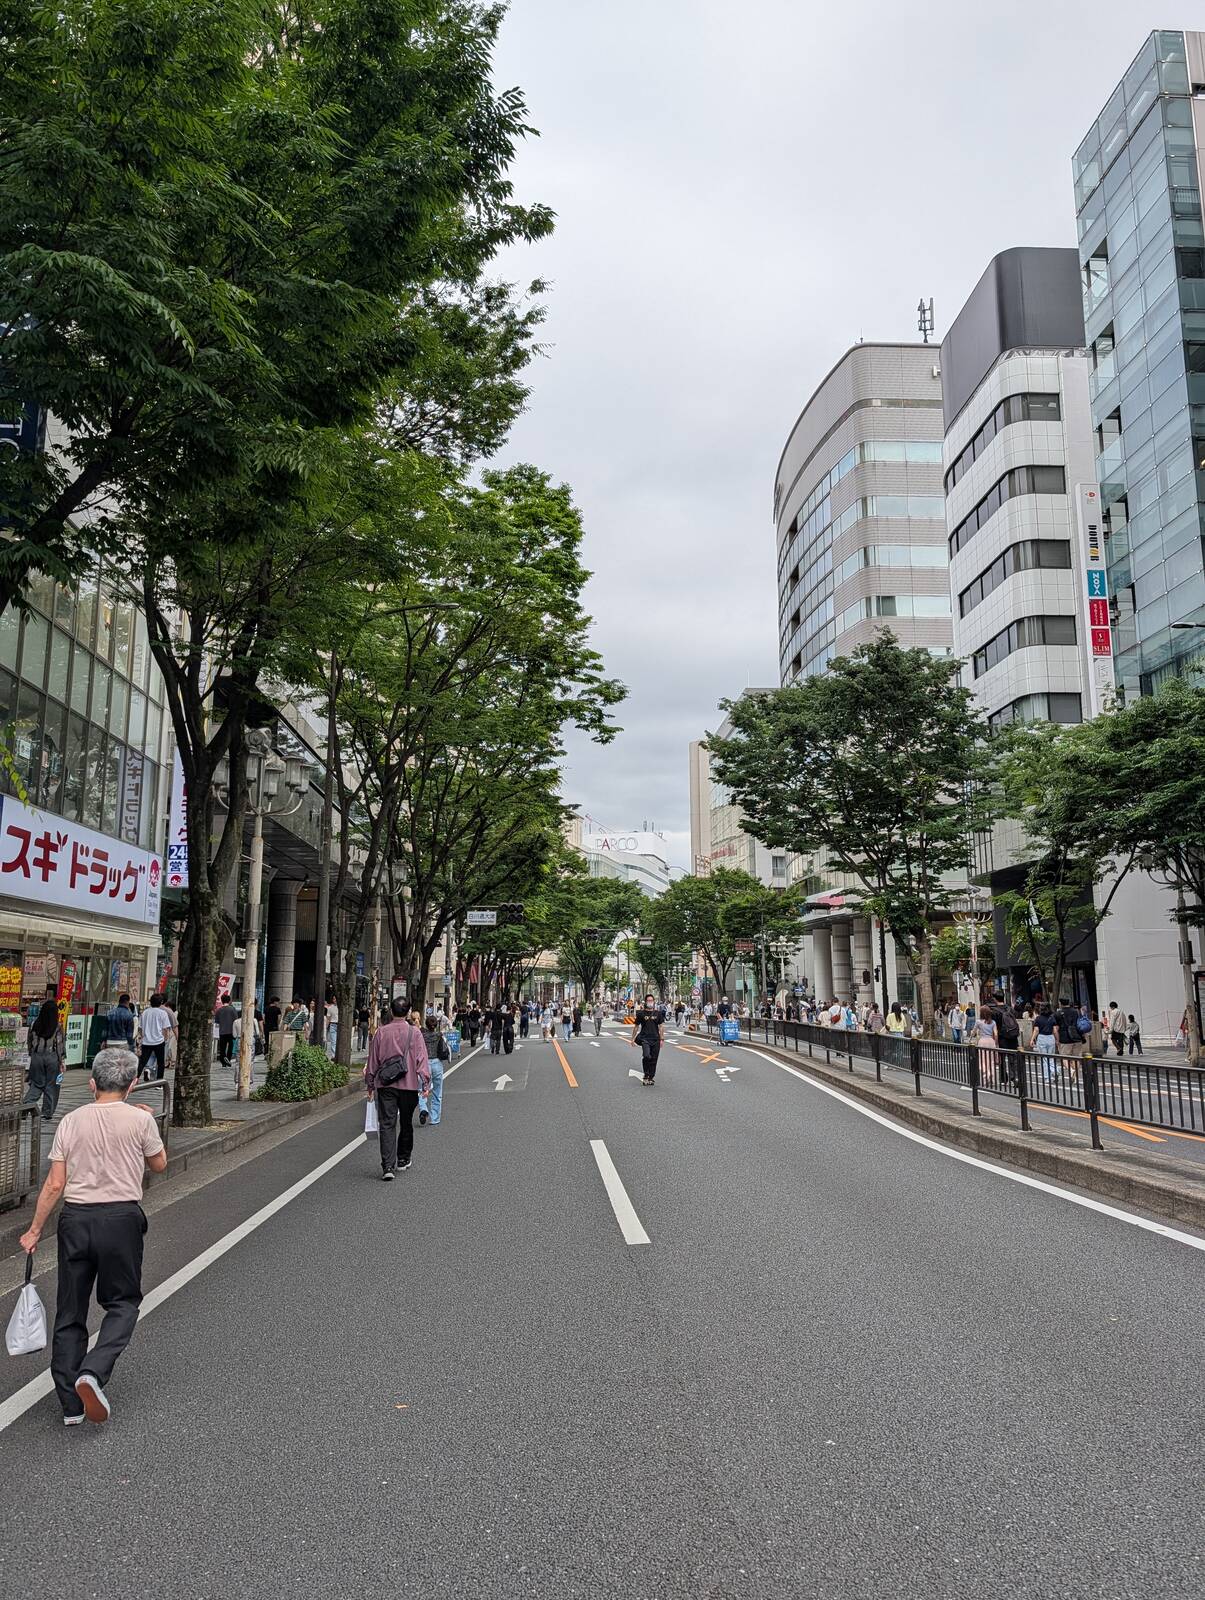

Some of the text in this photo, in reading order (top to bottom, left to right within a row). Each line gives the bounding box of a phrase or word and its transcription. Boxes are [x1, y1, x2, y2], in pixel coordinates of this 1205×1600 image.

[1088, 525, 1099, 561] DOUTOR
[1092, 572, 1101, 595] NOVA
[595, 837, 638, 850] PARCO
[2, 825, 145, 902] スギドラッグ
